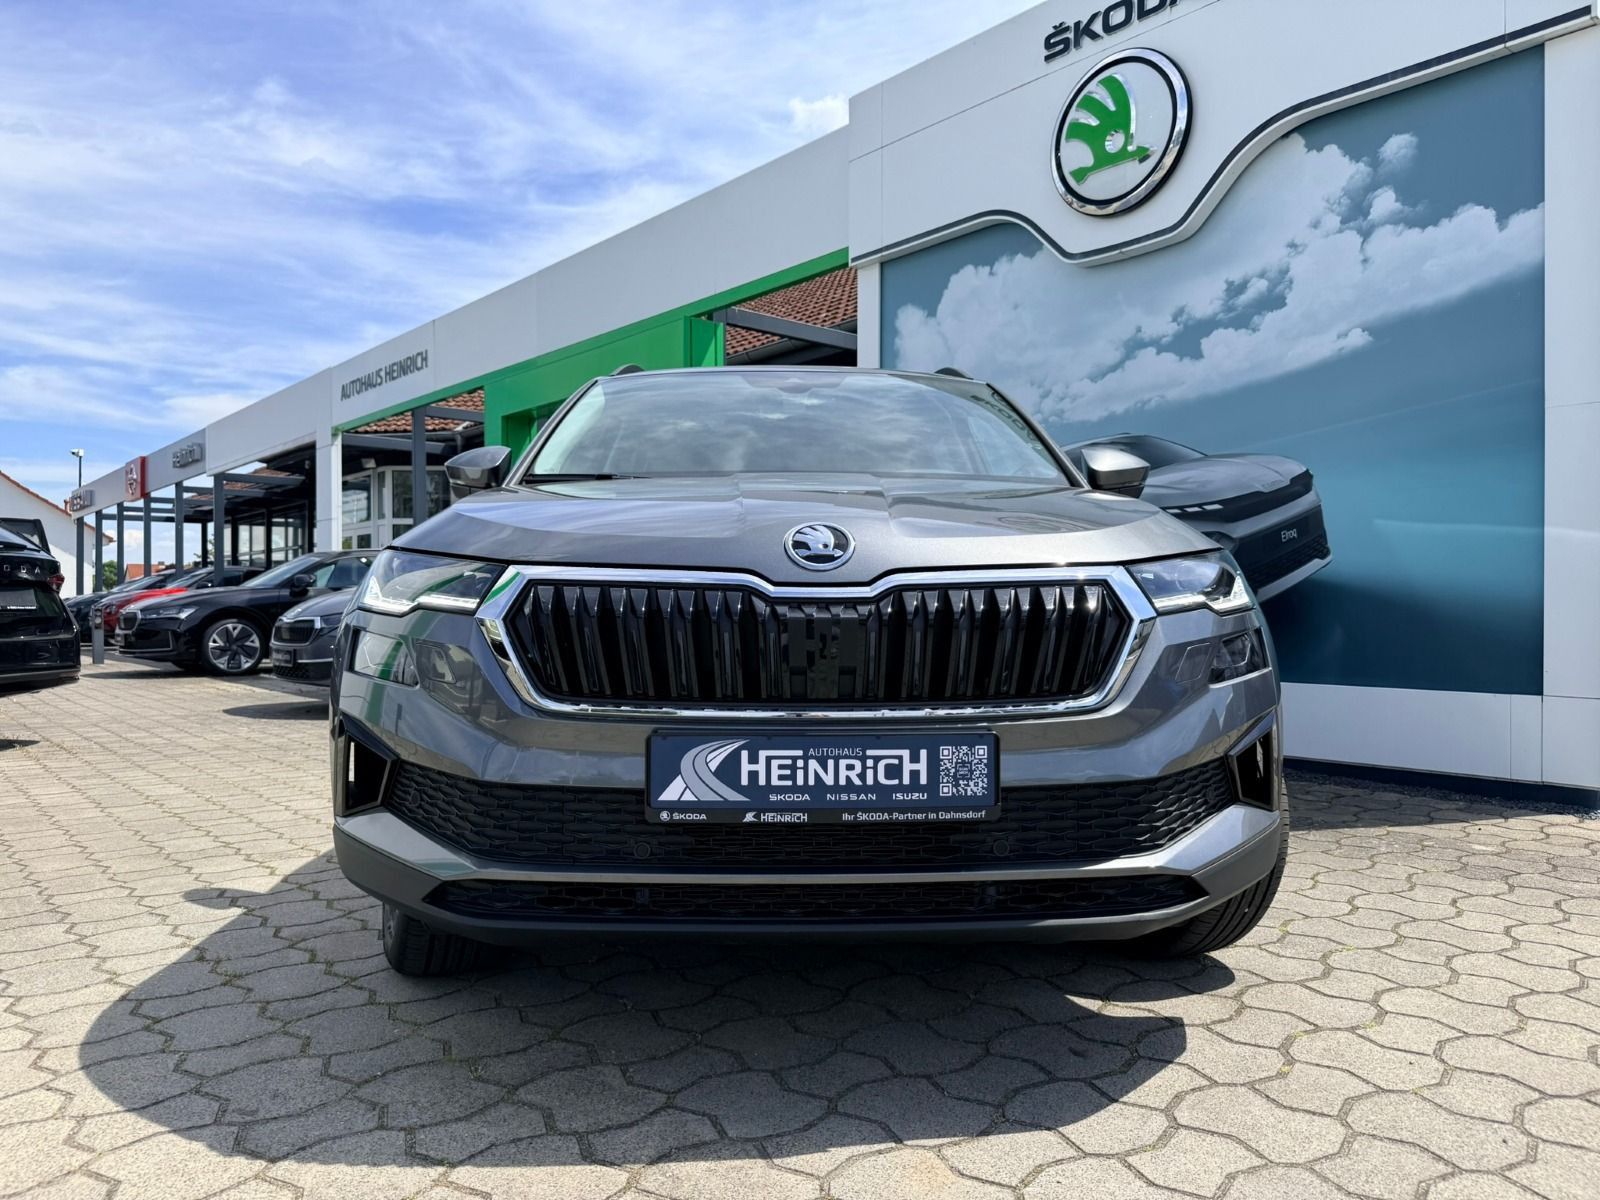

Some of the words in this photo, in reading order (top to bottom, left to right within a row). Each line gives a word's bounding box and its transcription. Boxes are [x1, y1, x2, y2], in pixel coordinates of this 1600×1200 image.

[1044, 0, 1178, 63] ŠKOD
[341, 368, 383, 402] AUTOHAUS
[384, 349, 428, 383] HEINRICH
[808, 748, 863, 757] AUTOHAUS
[826, 793, 877, 801] NISSAN
[892, 792, 928, 800] ISUZU
[842, 812, 855, 821] Ihr
[856, 811, 927, 821] ŠKODA-Partner
[928, 811, 937, 820] in
[938, 809, 987, 820] Dahnsdorf
